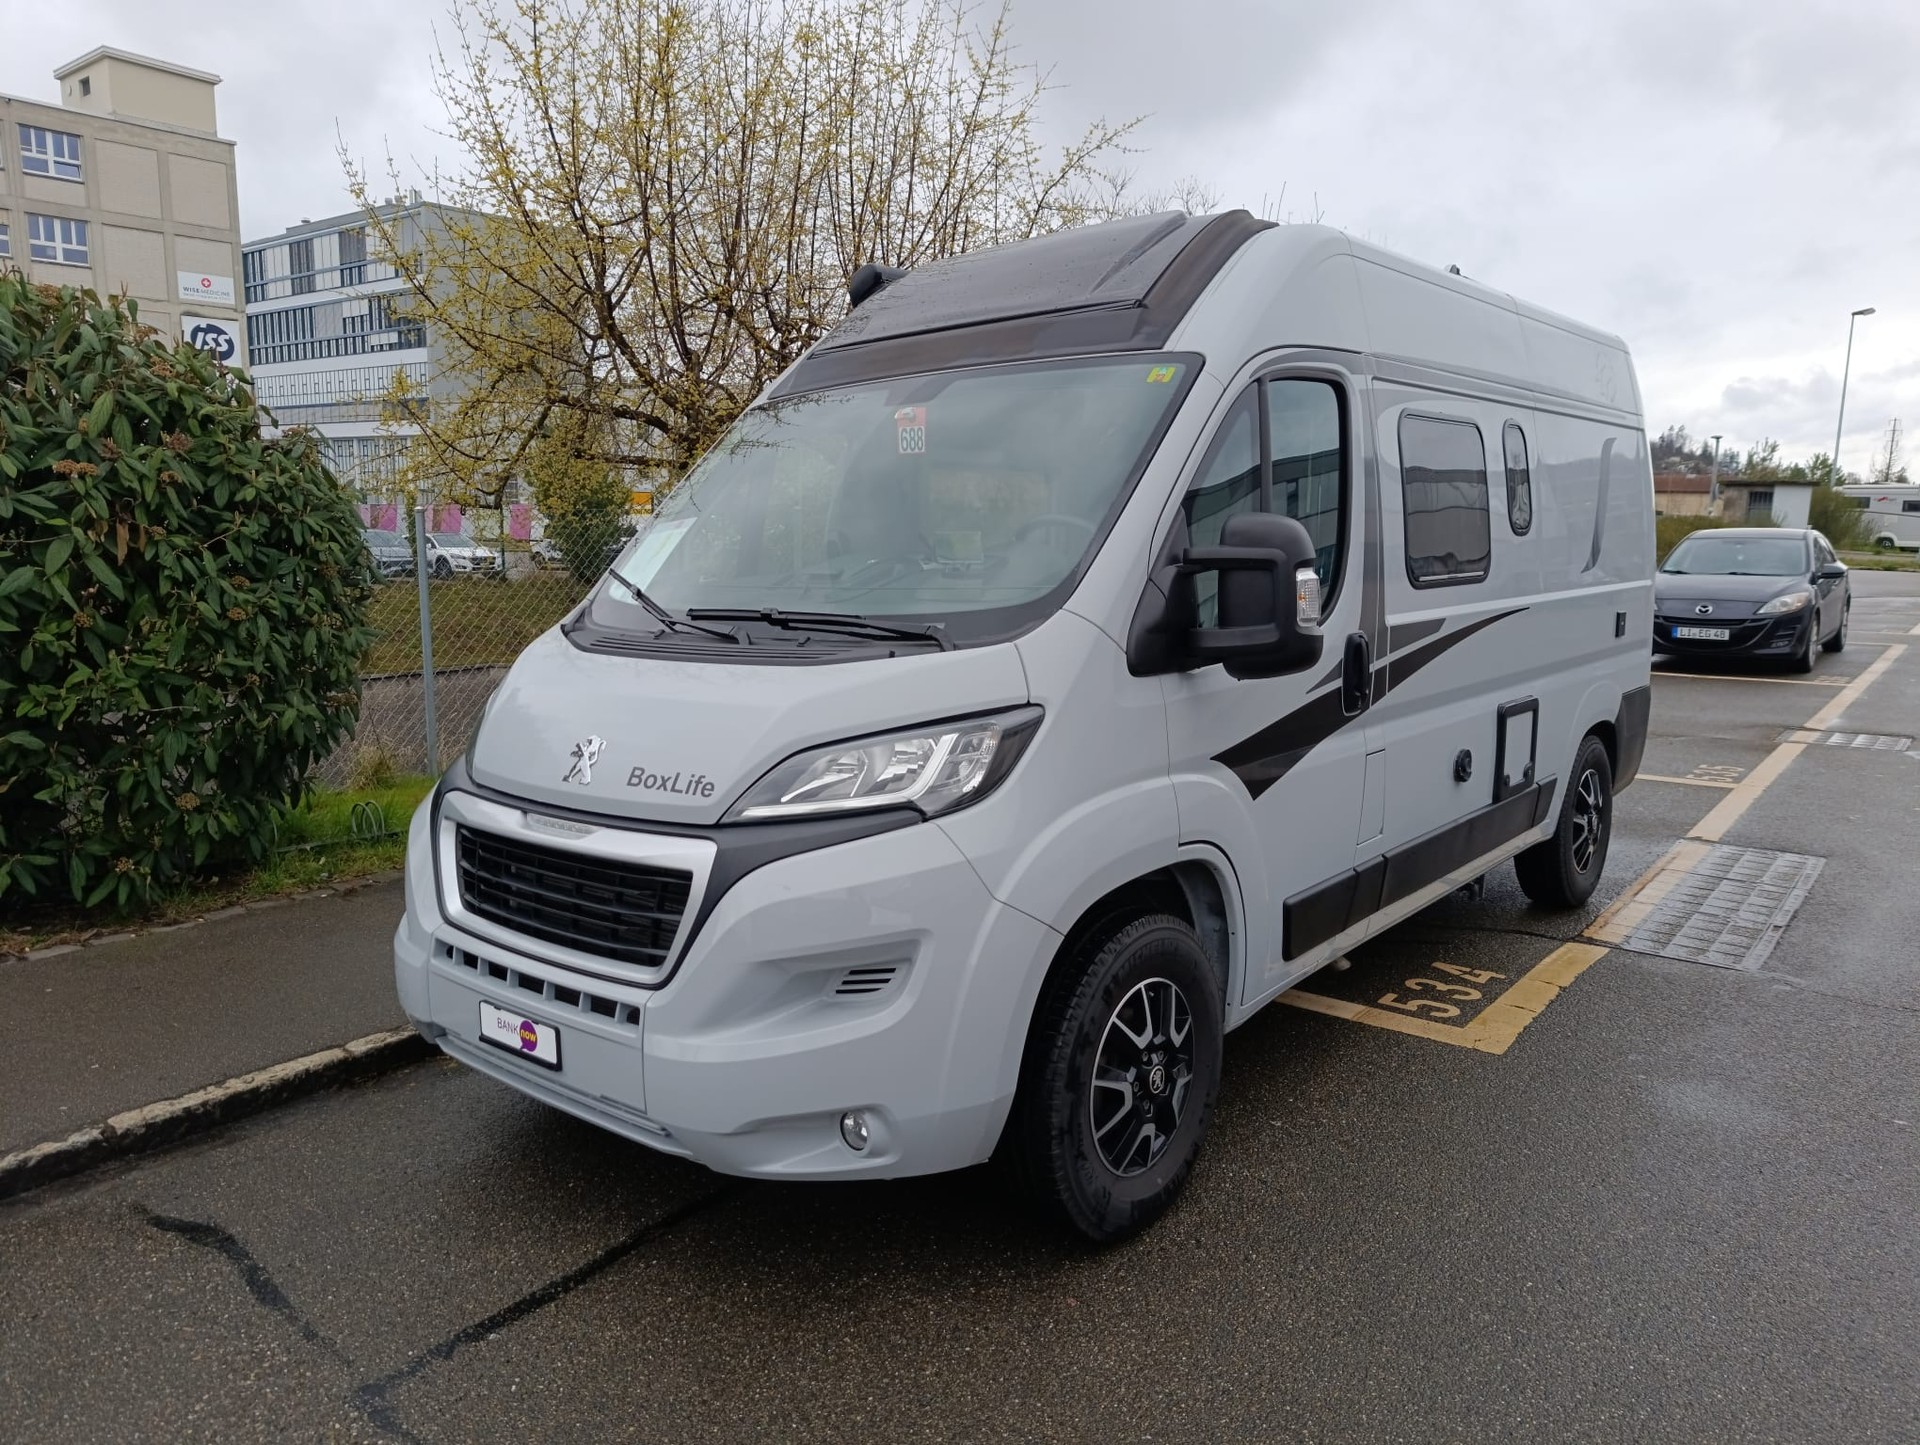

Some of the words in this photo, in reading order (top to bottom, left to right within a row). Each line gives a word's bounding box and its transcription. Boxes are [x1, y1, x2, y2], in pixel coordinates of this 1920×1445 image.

[900, 427, 924, 452] 688
[627, 766, 715, 798] BoxLife
[1377, 962, 1506, 1018] 534
[497, 1017, 519, 1036] BANK
[520, 1029, 536, 1042] now
